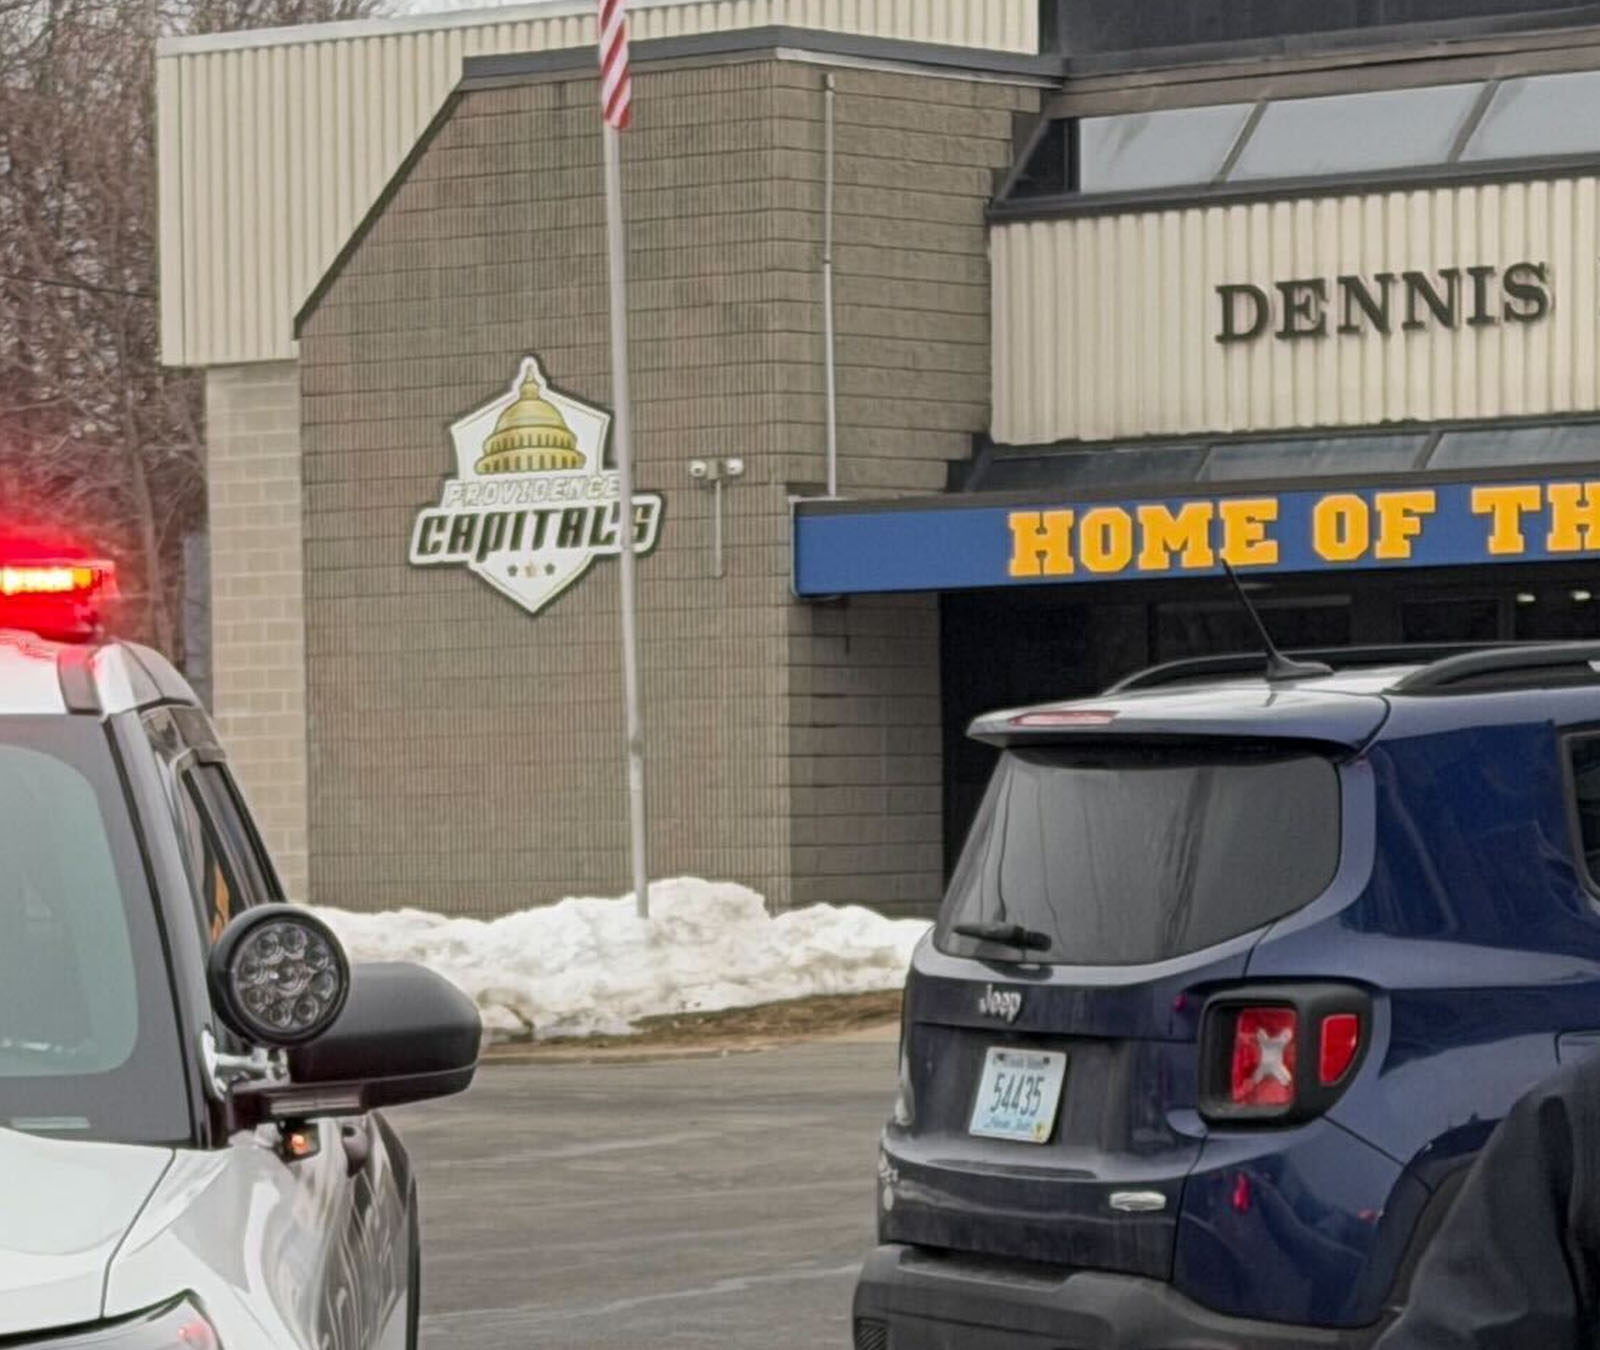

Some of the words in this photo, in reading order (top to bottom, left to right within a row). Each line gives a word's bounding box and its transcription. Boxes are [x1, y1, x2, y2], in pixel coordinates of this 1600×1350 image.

[1215, 262, 1551, 343] DENNIS
[416, 502, 655, 563] CAPITALS
[1008, 498, 1278, 578] HOME
[1312, 489, 1436, 562] OF
[978, 983, 1022, 1023] Jeep
[990, 1072, 1046, 1117] 54435
